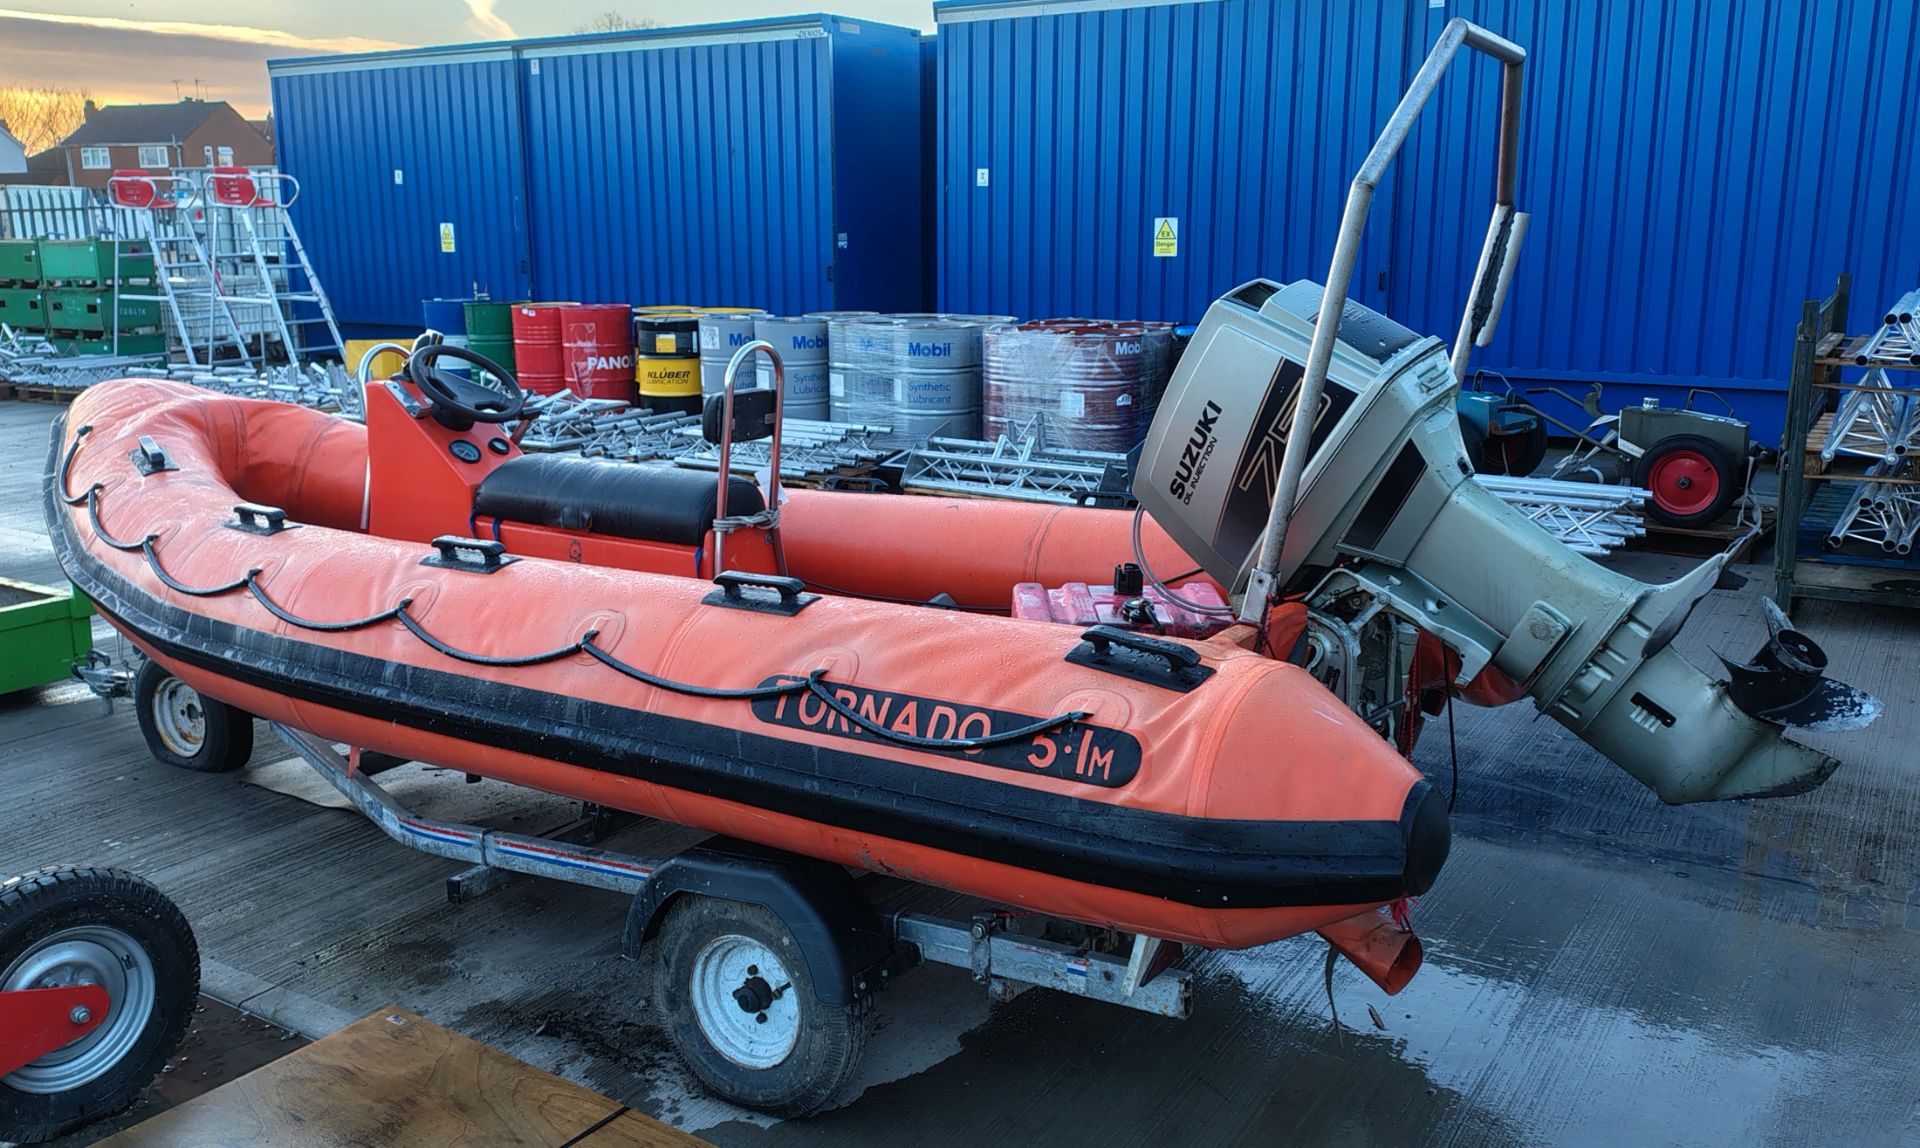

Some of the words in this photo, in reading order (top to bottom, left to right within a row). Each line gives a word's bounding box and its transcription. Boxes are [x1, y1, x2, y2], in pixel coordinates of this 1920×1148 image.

[909, 342, 951, 357] Mobil
[1115, 340, 1143, 355] Mob
[909, 381, 951, 393] Synthetic
[909, 394, 951, 405] Lubricant
[1170, 400, 1222, 499] SUZUKI
[1190, 436, 1218, 489] INJECTION
[1183, 490, 1194, 505] OIL
[775, 679, 992, 755] TORNADO
